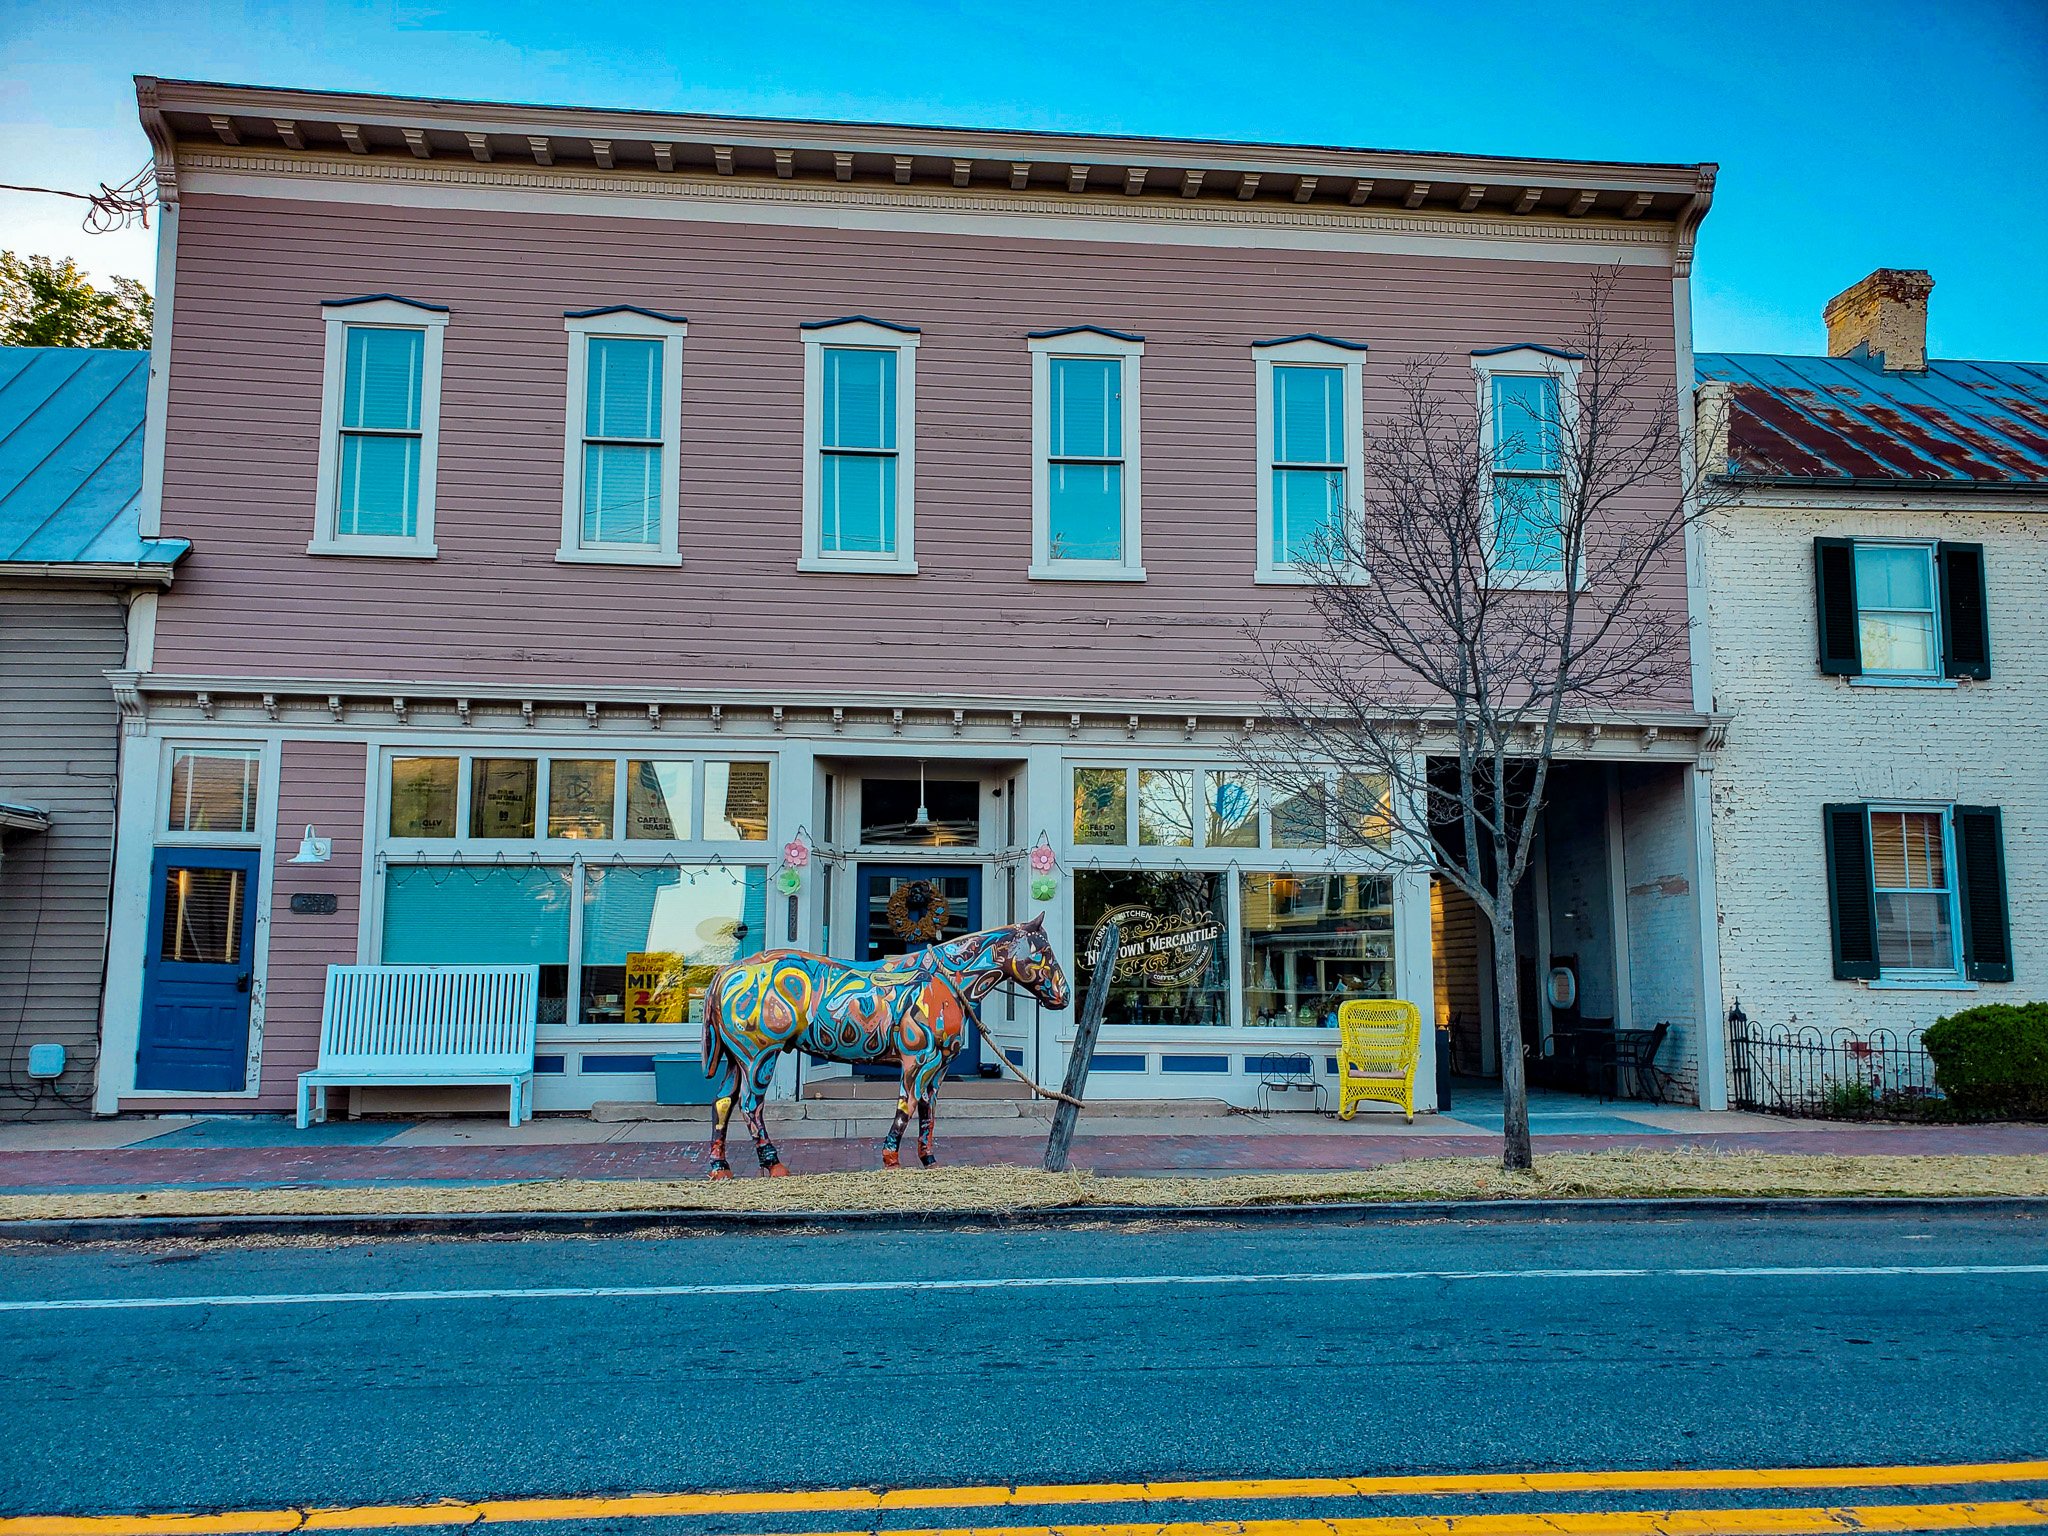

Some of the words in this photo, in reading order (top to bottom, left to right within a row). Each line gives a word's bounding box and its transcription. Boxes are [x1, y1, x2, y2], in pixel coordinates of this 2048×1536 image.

[1093, 925, 1109, 947] FARM
[1106, 916, 1117, 925] TO
[1146, 926, 1218, 953] MERCANTILE
[1184, 943, 1197, 953] LLC
